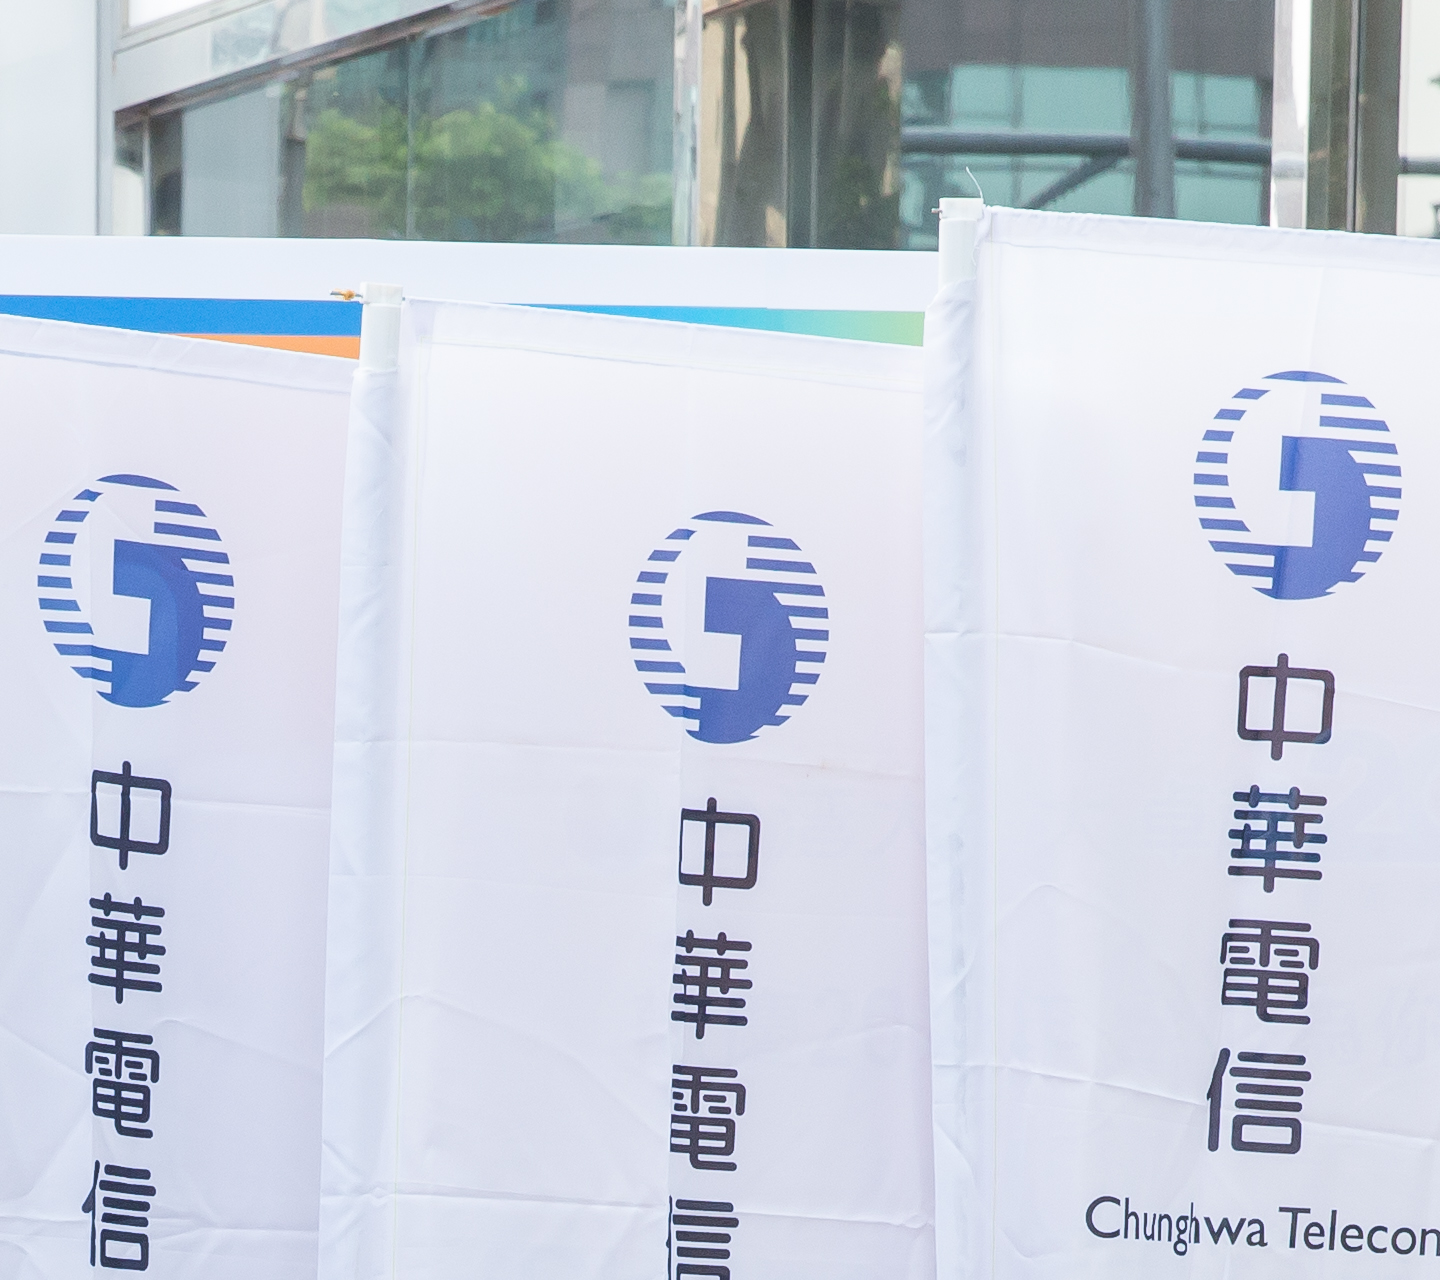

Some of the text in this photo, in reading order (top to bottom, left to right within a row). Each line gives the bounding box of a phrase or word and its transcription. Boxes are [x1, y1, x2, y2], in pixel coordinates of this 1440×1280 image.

[82, 761, 172, 1271] 中華電信
[1207, 653, 1335, 1154] 中華電信
[1086, 1196, 1267, 1256] Chunghwa
